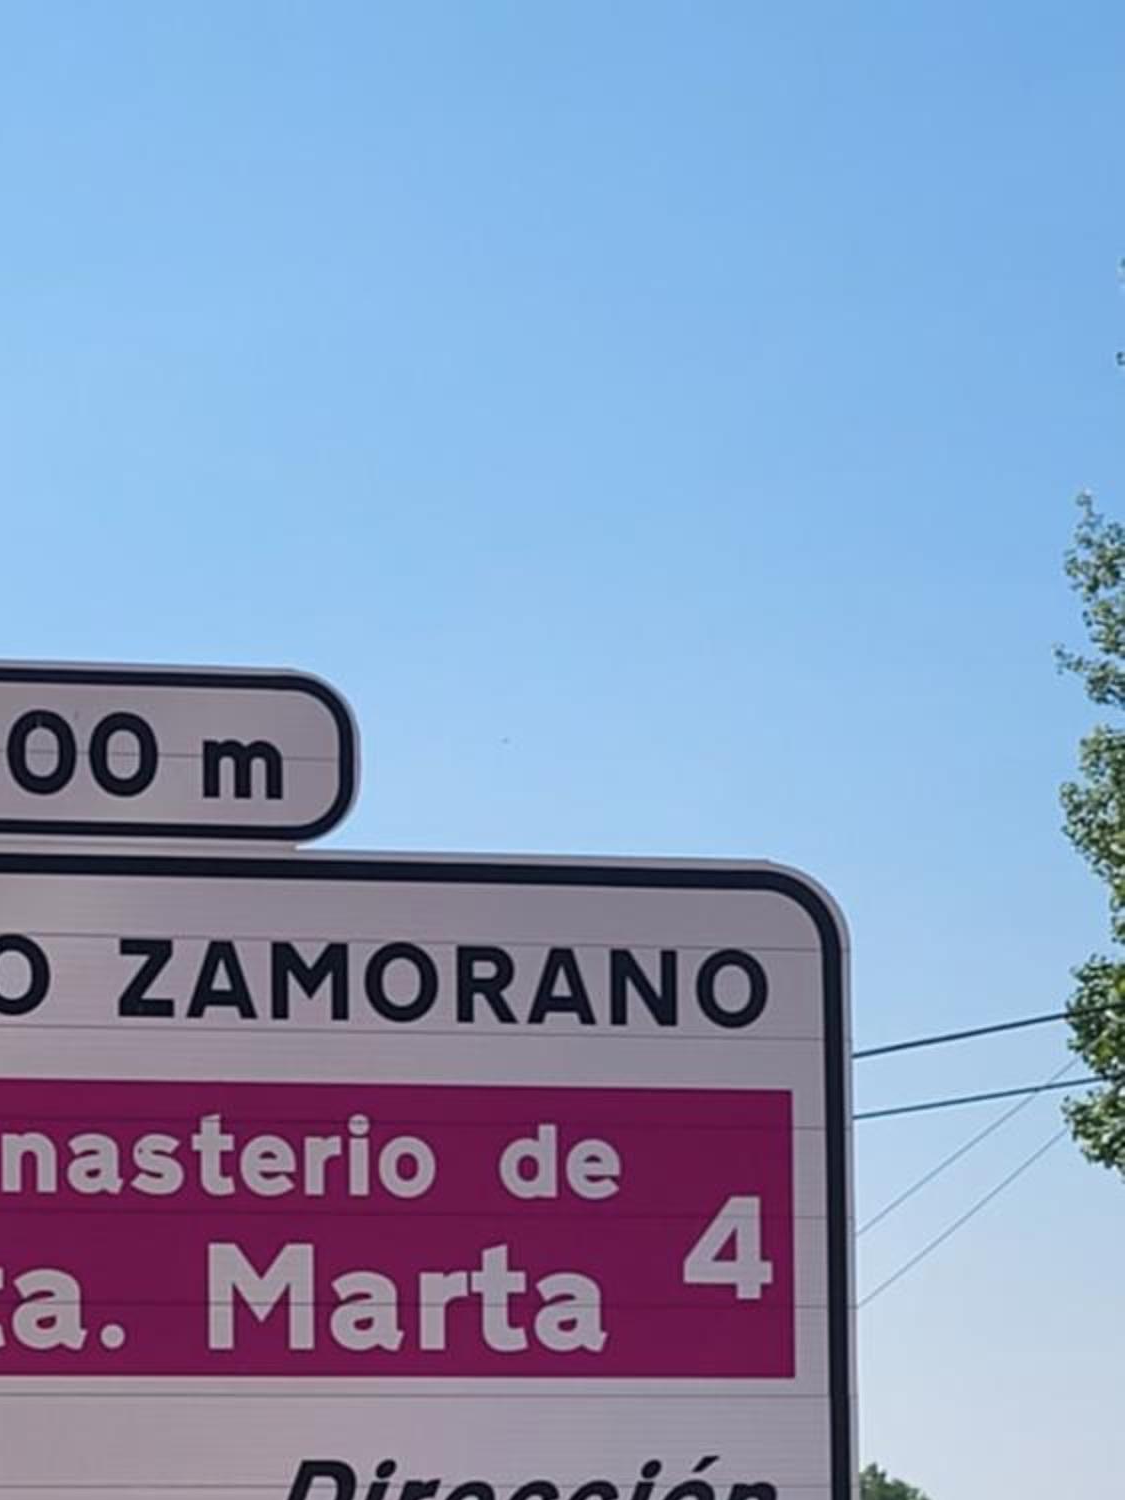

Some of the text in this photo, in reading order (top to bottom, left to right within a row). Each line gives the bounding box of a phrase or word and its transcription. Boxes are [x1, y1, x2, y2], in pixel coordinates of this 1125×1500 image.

[202, 739, 284, 801] m
[118, 937, 769, 1029] ZAMORANO
[499, 1123, 621, 1199] de
[683, 1196, 773, 1300] 4
[208, 1242, 608, 1352] Marta
